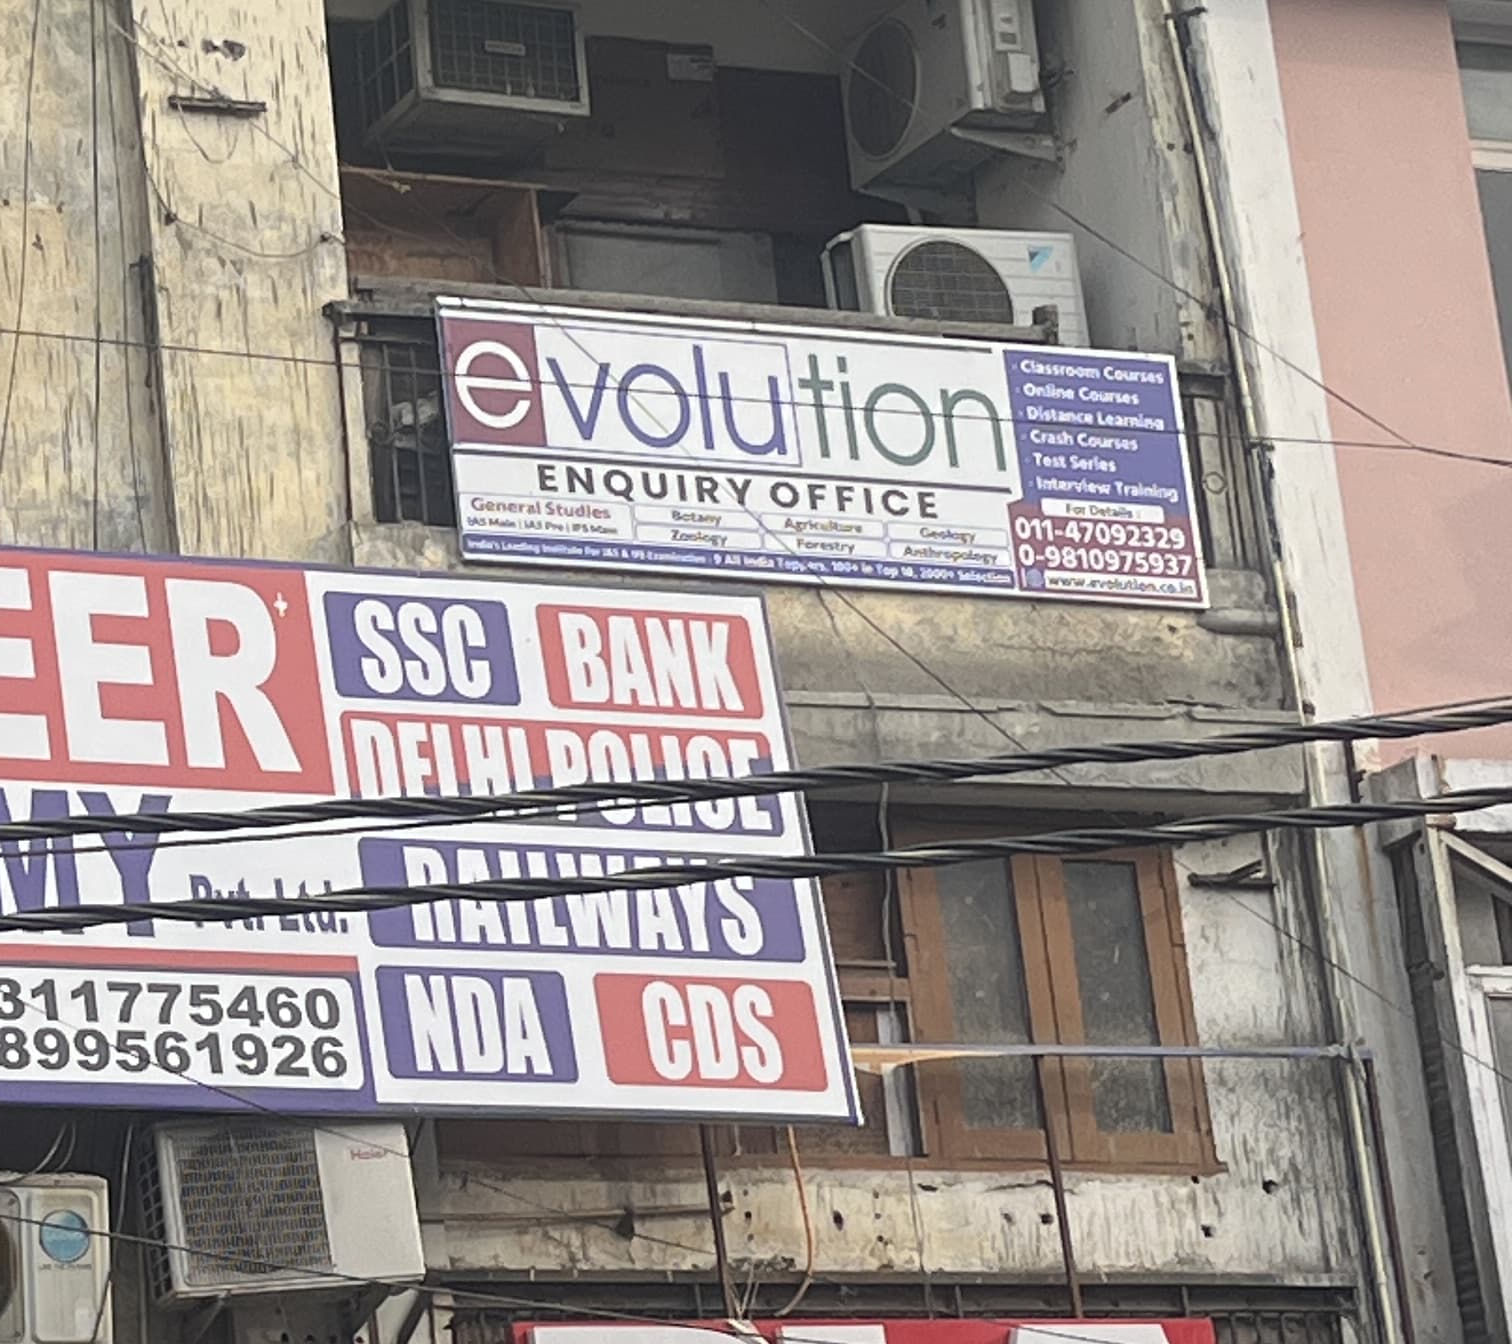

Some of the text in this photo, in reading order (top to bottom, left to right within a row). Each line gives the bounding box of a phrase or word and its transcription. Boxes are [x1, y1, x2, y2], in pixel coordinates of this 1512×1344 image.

[1020, 360, 1164, 384] Classroom Courses
[1023, 383, 1139, 405] Online Courses
[454, 340, 1006, 472] evolution
[1026, 406, 1093, 424] Distance
[1030, 430, 1138, 451] Crash Courses
[1032, 452, 1117, 472] Test Series
[537, 464, 939, 520] ENQUIRY OFFICE
[1036, 476, 1178, 503] Interview Training
[471, 497, 611, 519] General Studies
[919, 528, 976, 543] Geology
[1015, 517, 1184, 549] 011-47092329
[797, 539, 855, 555] Forestry
[904, 546, 998, 565] Anthropology
[1019, 544, 1191, 575] 0-9810975937
[353, 598, 744, 712] SSC BANK
[404, 974, 784, 1084] NDA CDS
